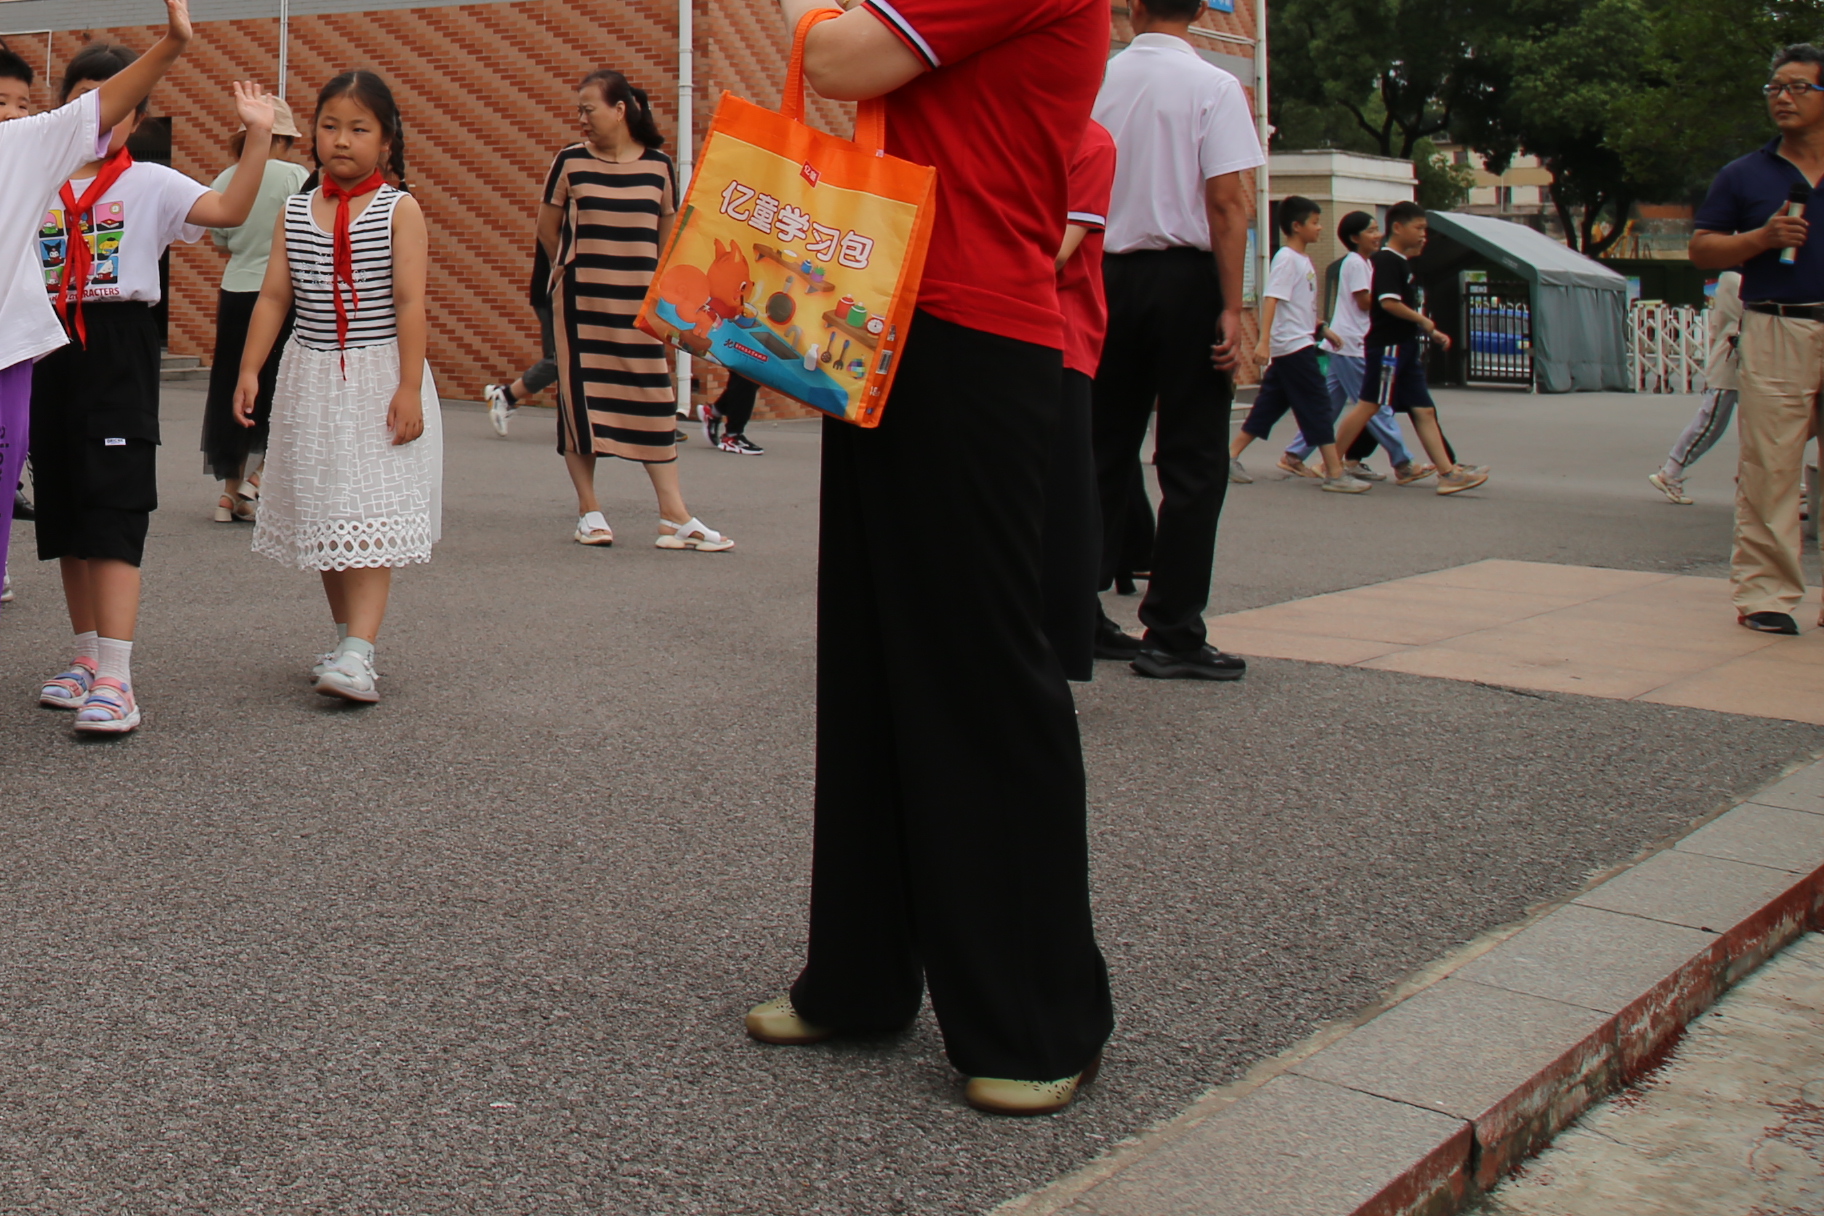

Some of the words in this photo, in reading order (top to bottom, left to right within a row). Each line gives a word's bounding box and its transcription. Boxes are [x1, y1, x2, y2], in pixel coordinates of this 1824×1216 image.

[719, 180, 875, 270] 亿童学习包
